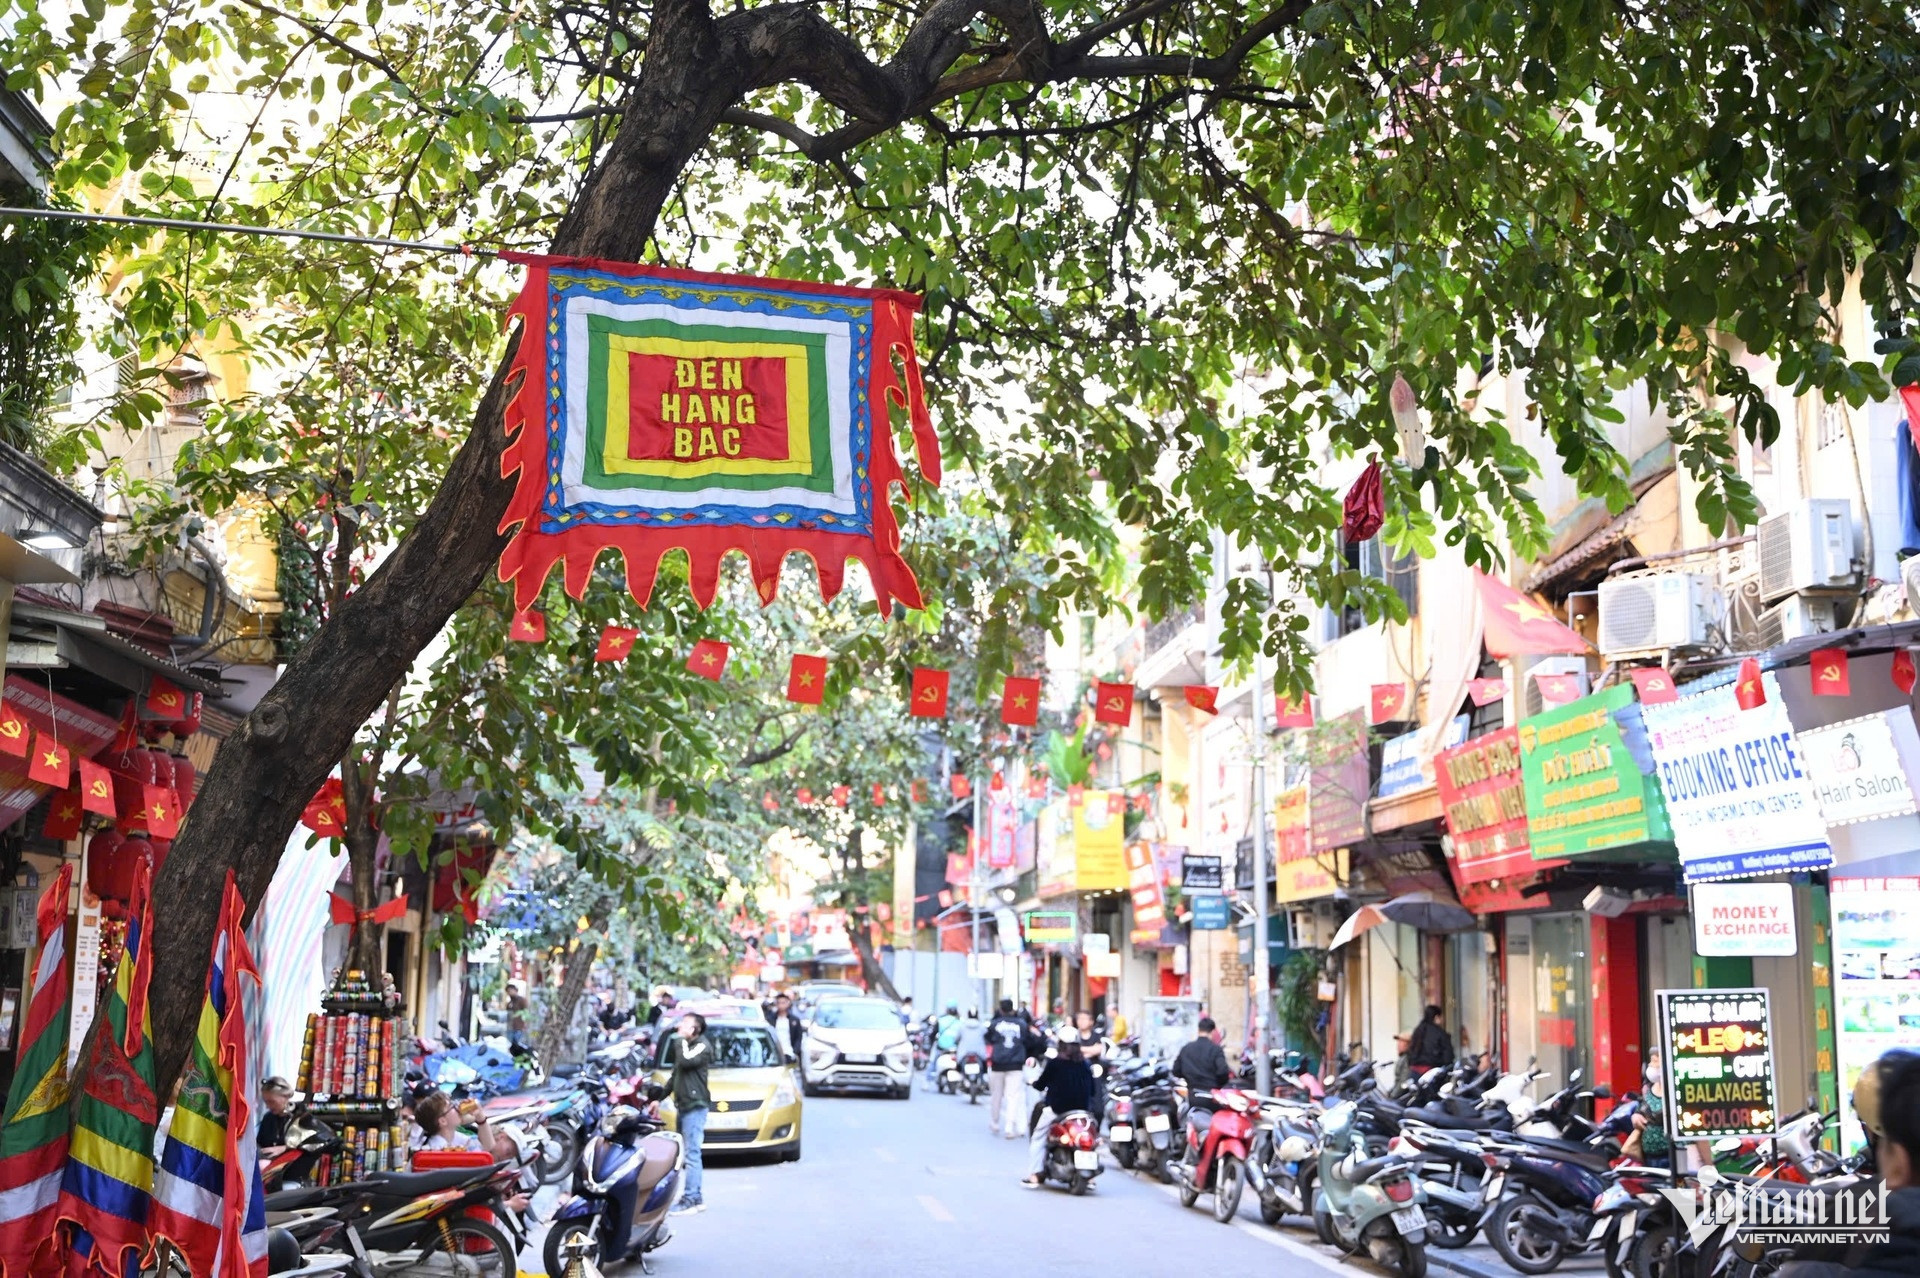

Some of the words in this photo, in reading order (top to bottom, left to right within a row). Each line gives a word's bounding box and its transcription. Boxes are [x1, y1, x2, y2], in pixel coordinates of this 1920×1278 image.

[661, 392, 756, 425] HANG
[674, 426, 741, 458] BAC
[1662, 747, 1738, 803] BOOKING
[1734, 732, 1803, 788] OFFICE
[1819, 780, 1852, 804] Hair
[1855, 774, 1903, 798] Salon
[1713, 905, 1778, 920] MONEY
[1703, 922, 1790, 936] EXCHANGE
[1675, 1002, 1712, 1023] HAIR
[1712, 1001, 1761, 1022] SALON
[1694, 1025, 1745, 1053] LEO
[1733, 1055, 1767, 1078] CUT
[1684, 1081, 1763, 1103] BALAYAGE
[1701, 1107, 1750, 1129] COLOR
